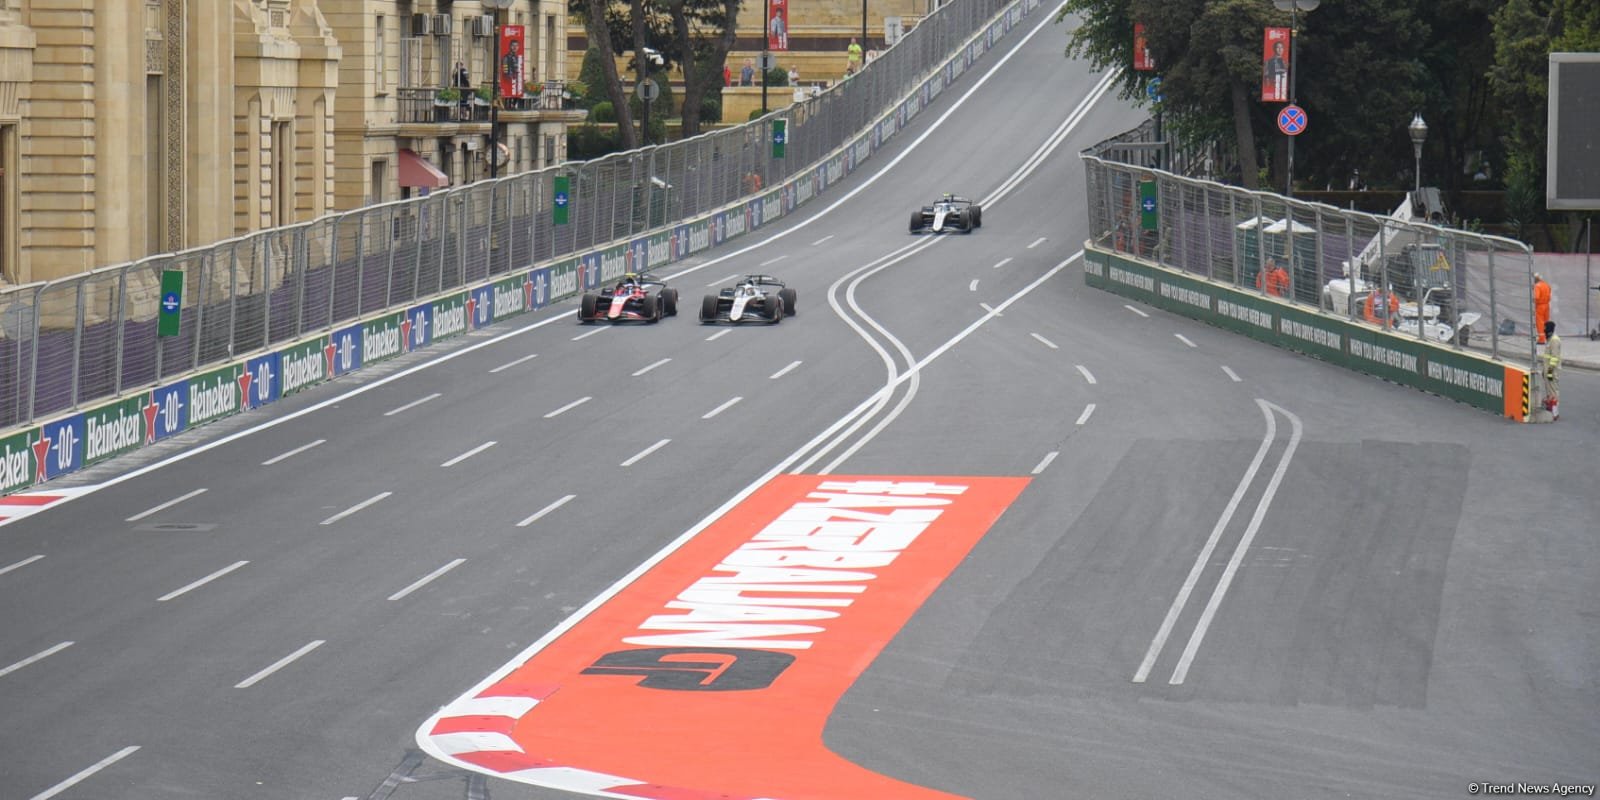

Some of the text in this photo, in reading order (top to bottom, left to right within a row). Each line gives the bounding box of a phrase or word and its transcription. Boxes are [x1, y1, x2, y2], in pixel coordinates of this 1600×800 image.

[432, 302, 465, 339] Heineken
[363, 322, 399, 362] Heineken
[1350, 338, 1417, 373] WHEN YOU DRIVE NEVER DRINK
[283, 348, 322, 391] Heineken
[1427, 360, 1503, 398] WHEN YOU DRIVE NEVER DRINK
[190, 376, 235, 424] Heineken
[86, 408, 140, 460] Heineken
[578, 647, 797, 691] GP
